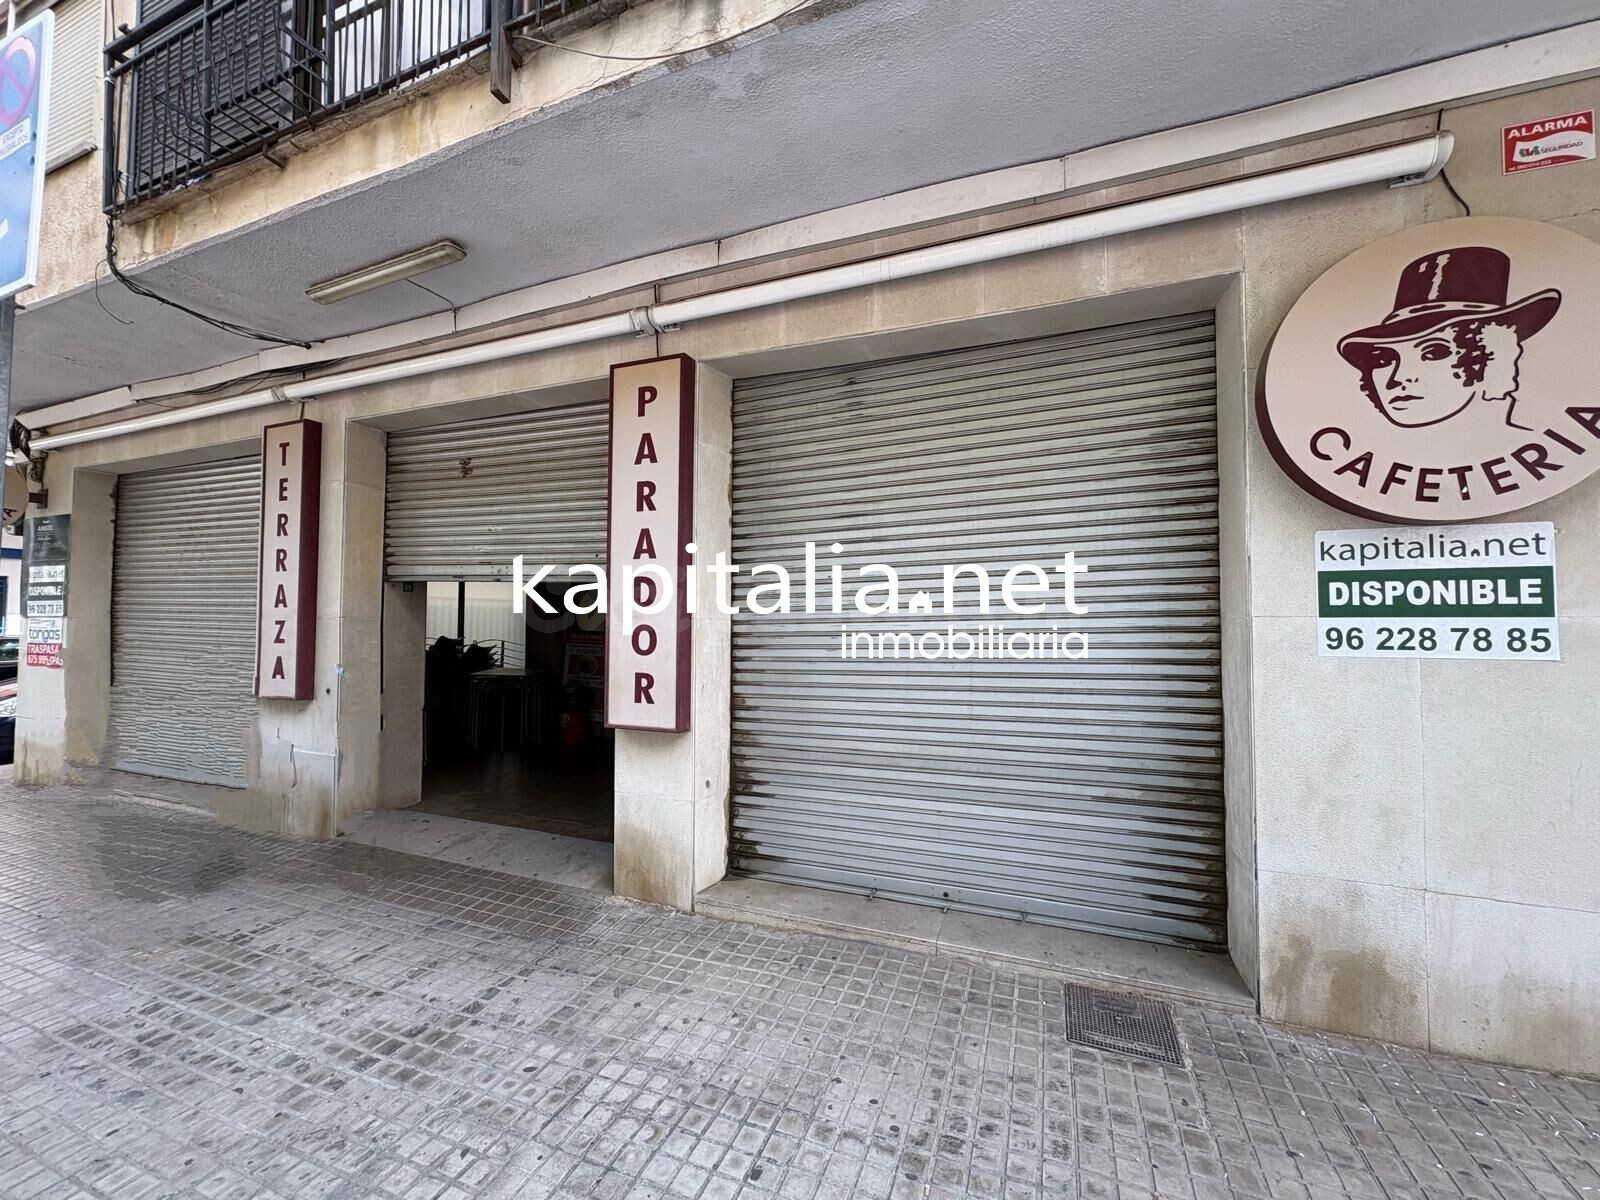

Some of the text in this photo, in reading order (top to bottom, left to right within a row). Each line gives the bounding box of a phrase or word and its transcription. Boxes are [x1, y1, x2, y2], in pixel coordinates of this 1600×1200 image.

[1508, 116, 1587, 139] ALARMA
[1541, 141, 1584, 154] SEGURIDAD
[1310, 406, 1600, 502] CAFETERIA
[632, 386, 658, 704] PARADOR
[1320, 532, 1547, 566] kapitalia.net
[272, 442, 290, 680] TERRAZA
[29, 586, 62, 596] DISPONIBLE
[1328, 578, 1543, 606] DISPONIBLE
[28, 644, 59, 655] TRASPASA
[1325, 627, 1551, 652] 96 228 78 85
